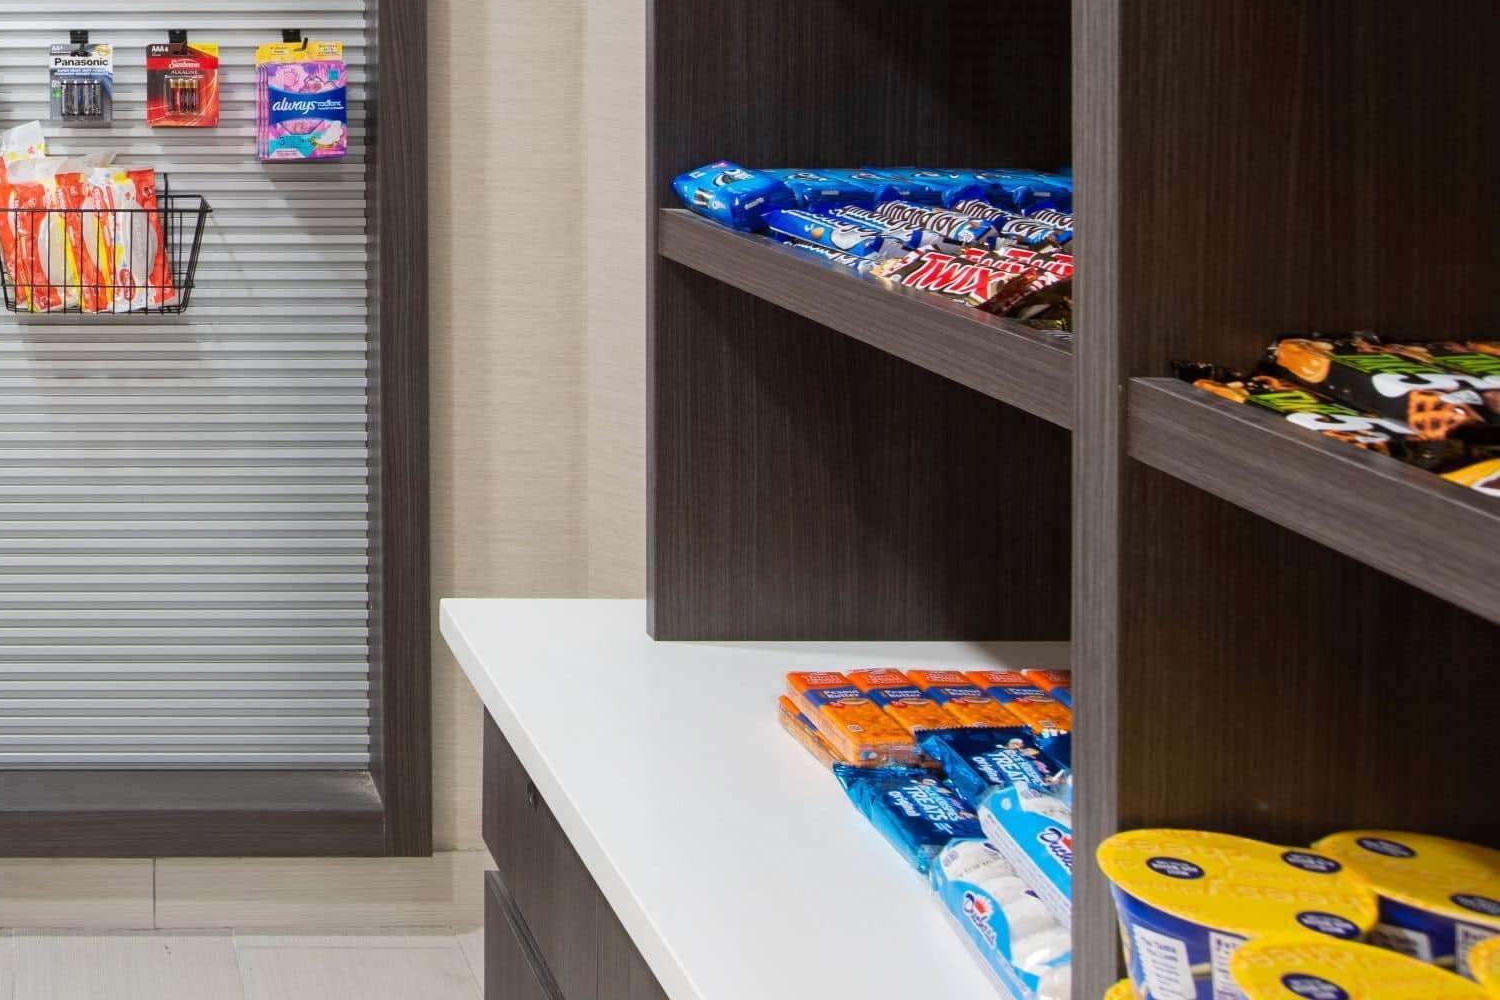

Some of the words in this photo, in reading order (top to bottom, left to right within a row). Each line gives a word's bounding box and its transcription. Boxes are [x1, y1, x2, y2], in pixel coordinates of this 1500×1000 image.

[54, 57, 108, 66] Panasonic
[272, 97, 316, 114] always
[902, 252, 1006, 302] TWIX
[988, 750, 1030, 781] TREAT
[902, 785, 949, 821] TREATS
